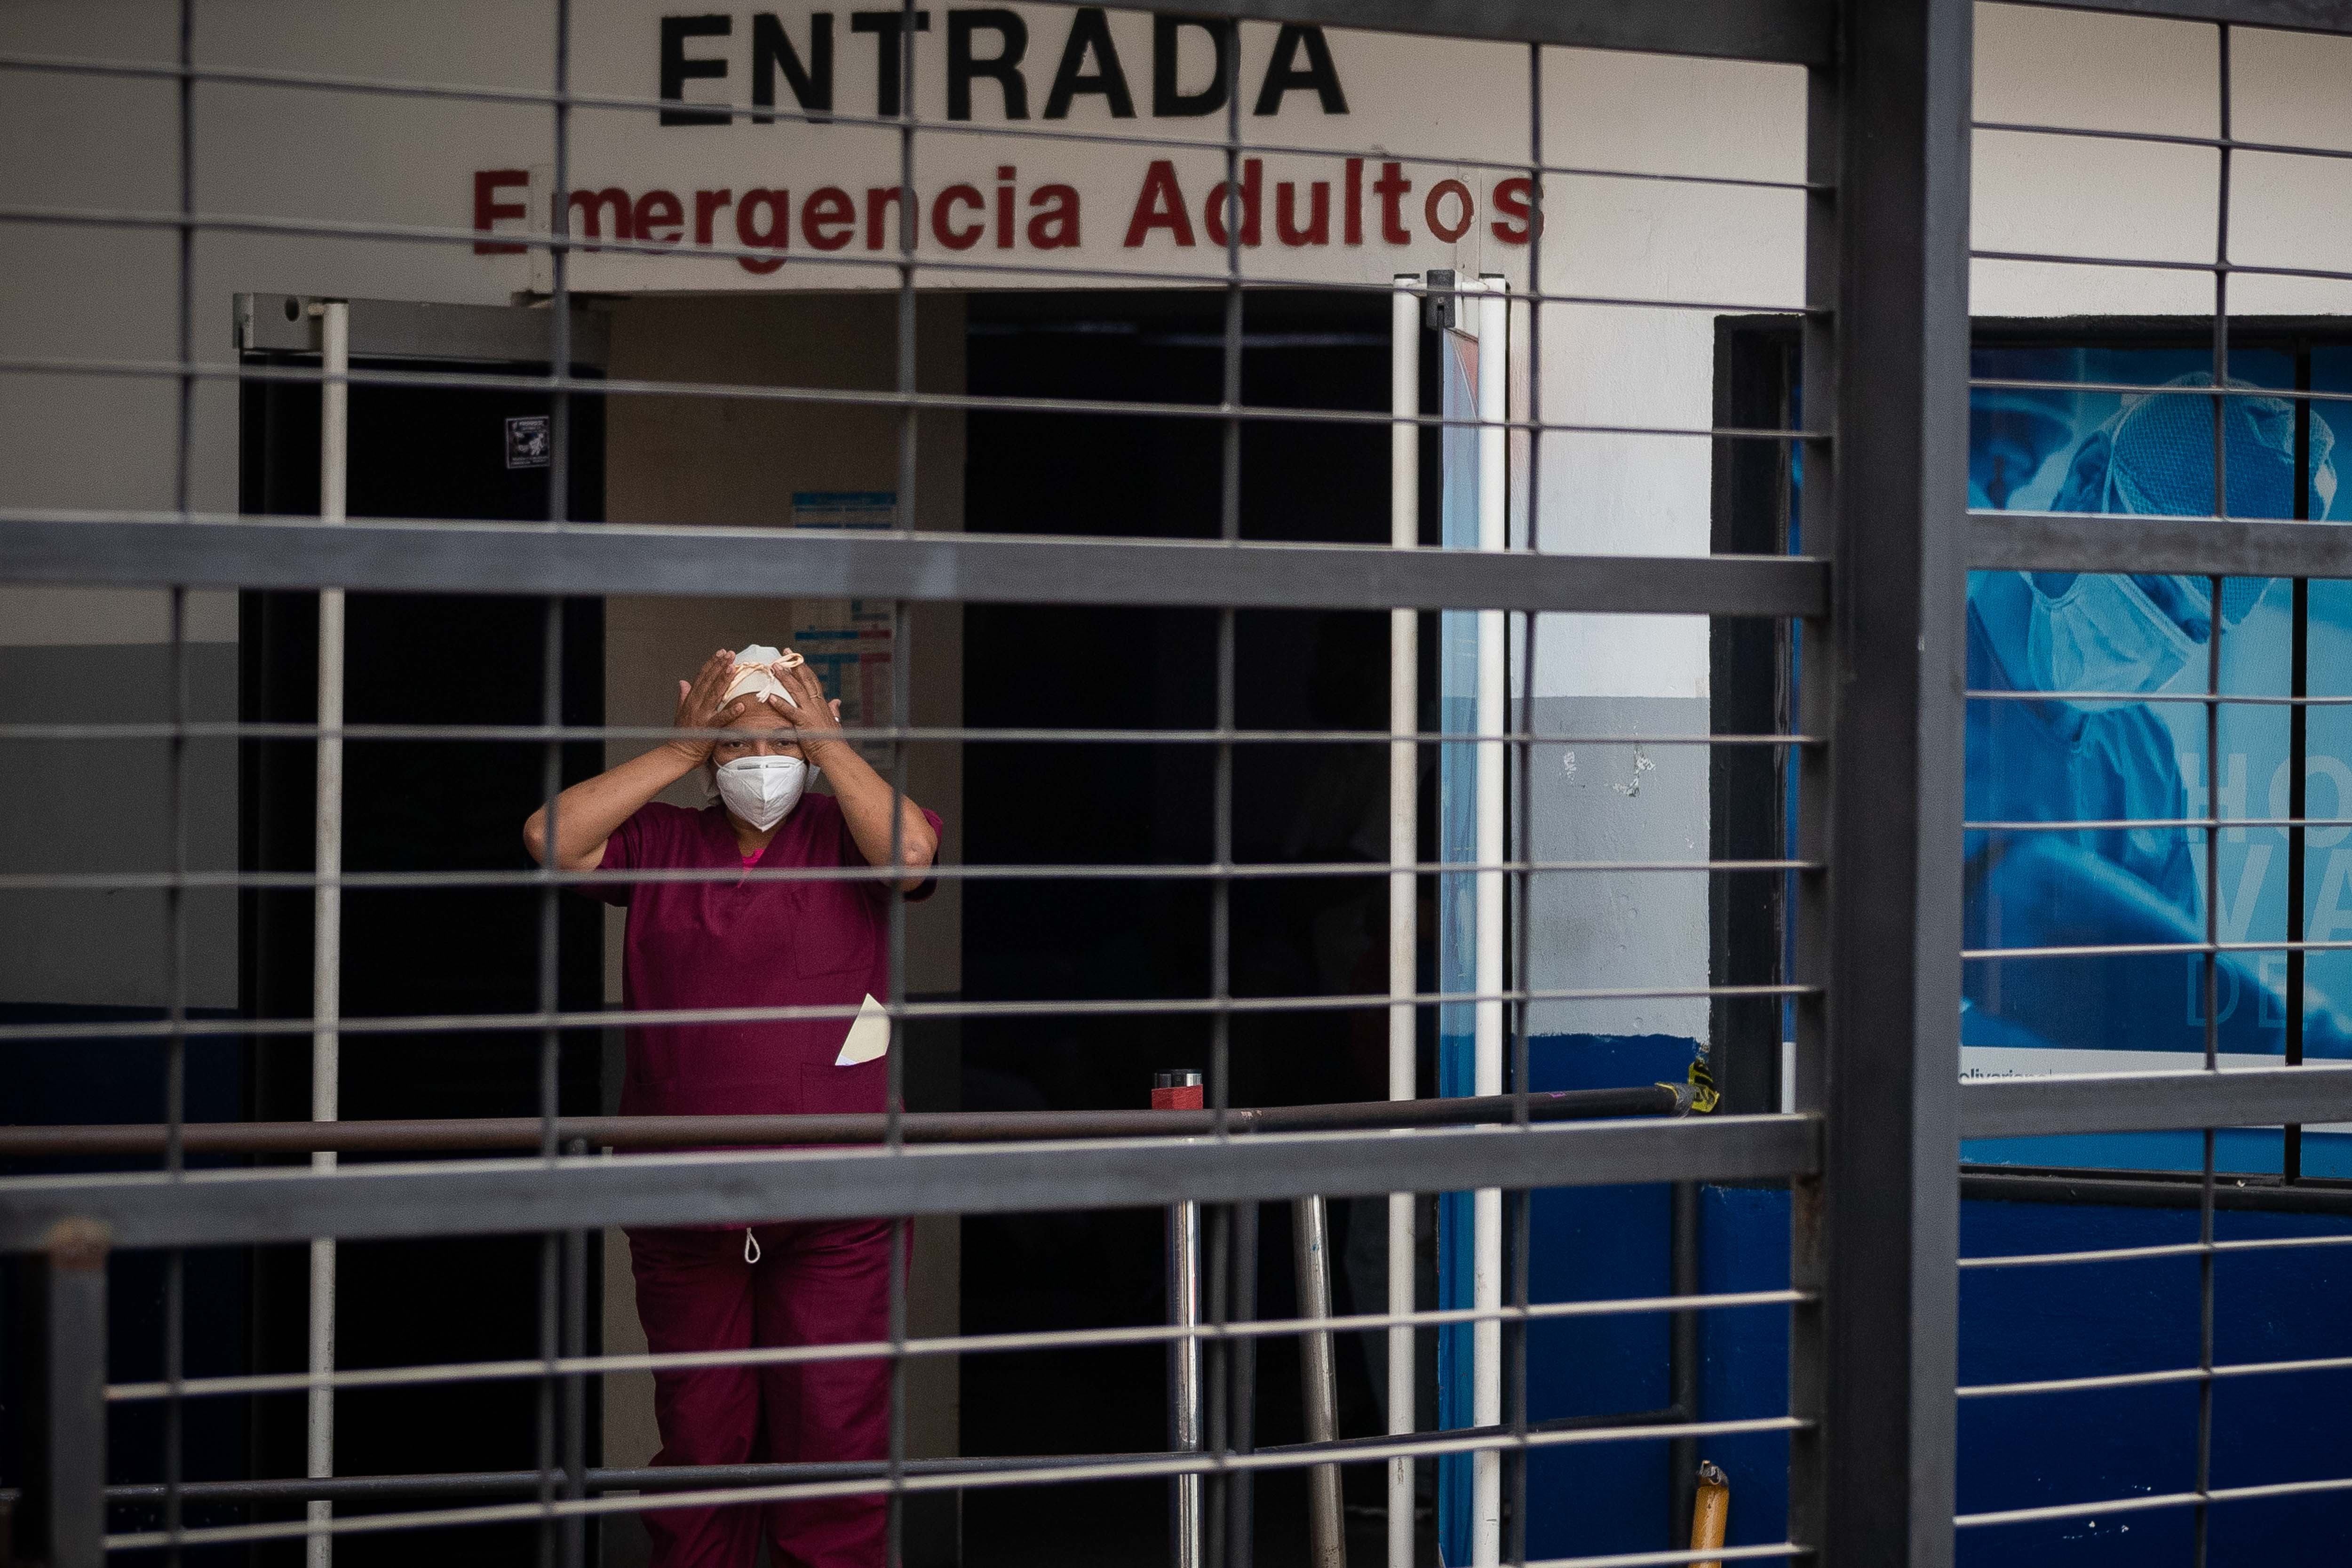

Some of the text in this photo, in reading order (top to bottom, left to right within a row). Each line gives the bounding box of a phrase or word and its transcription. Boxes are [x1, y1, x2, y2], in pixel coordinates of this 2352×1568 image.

[660, 8, 1349, 126] ENTRADA
[473, 158, 1545, 274] Emergencia Adultos
